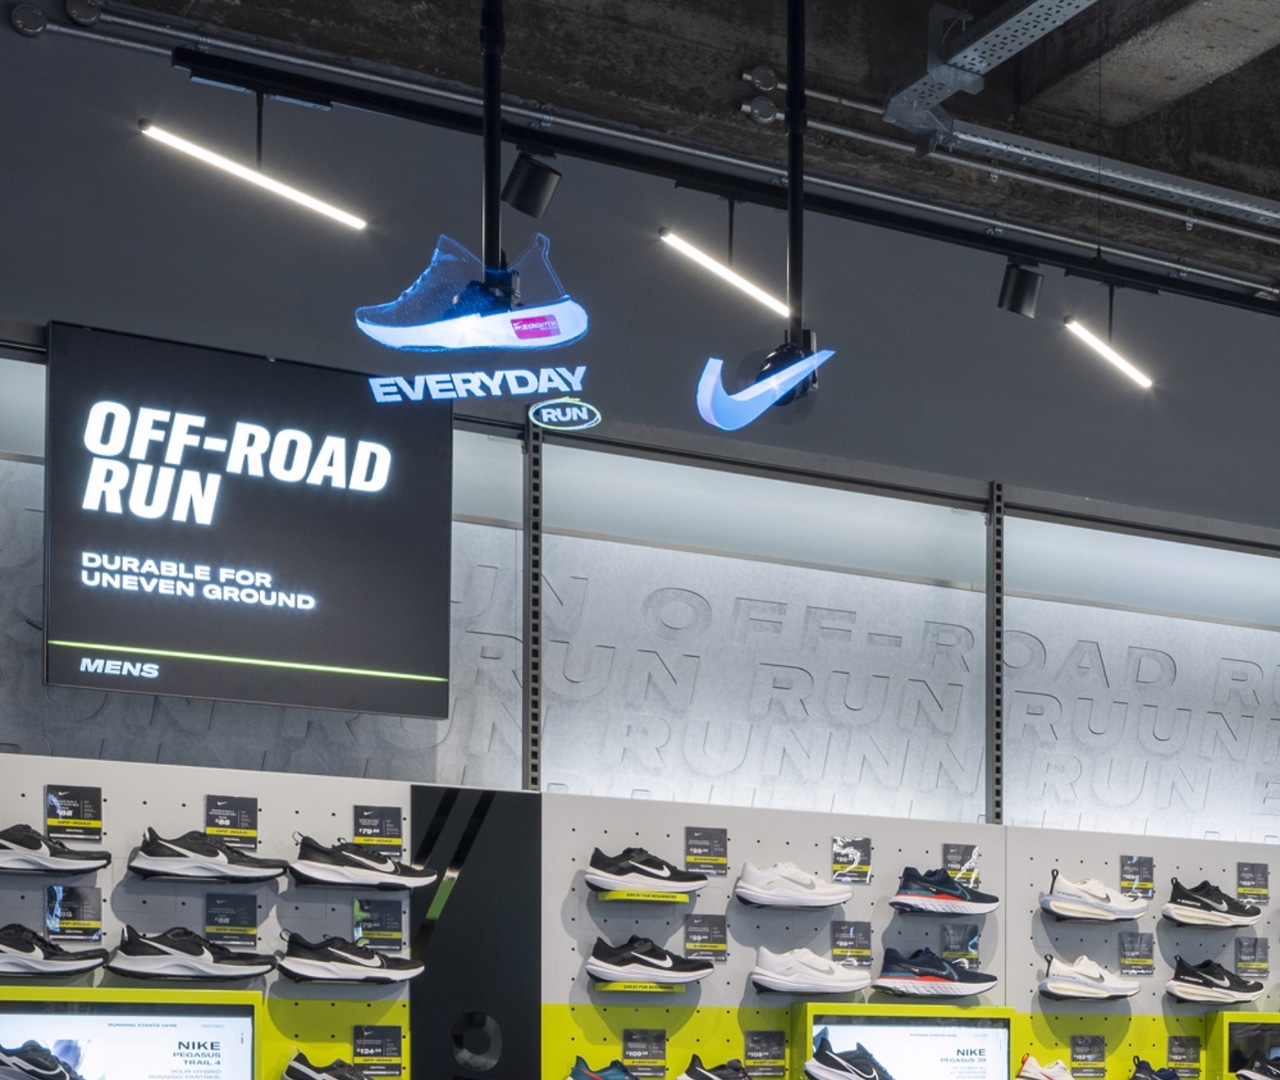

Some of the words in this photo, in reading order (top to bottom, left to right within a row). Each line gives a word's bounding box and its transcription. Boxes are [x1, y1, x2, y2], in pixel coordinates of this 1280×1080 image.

[368, 366, 587, 403] EVERYDAY
[540, 406, 589, 423] RUN
[83, 400, 392, 493] OFF-ROAD
[81, 457, 222, 525] RUN
[81, 551, 211, 581] DURABLE
[219, 568, 272, 588] FOR
[81, 570, 195, 597] UNEVEN
[202, 584, 316, 610] GROUND
[79, 657, 160, 678] MENS
[178, 1041, 221, 1051] NIKE
[956, 1048, 986, 1056] NIKE
